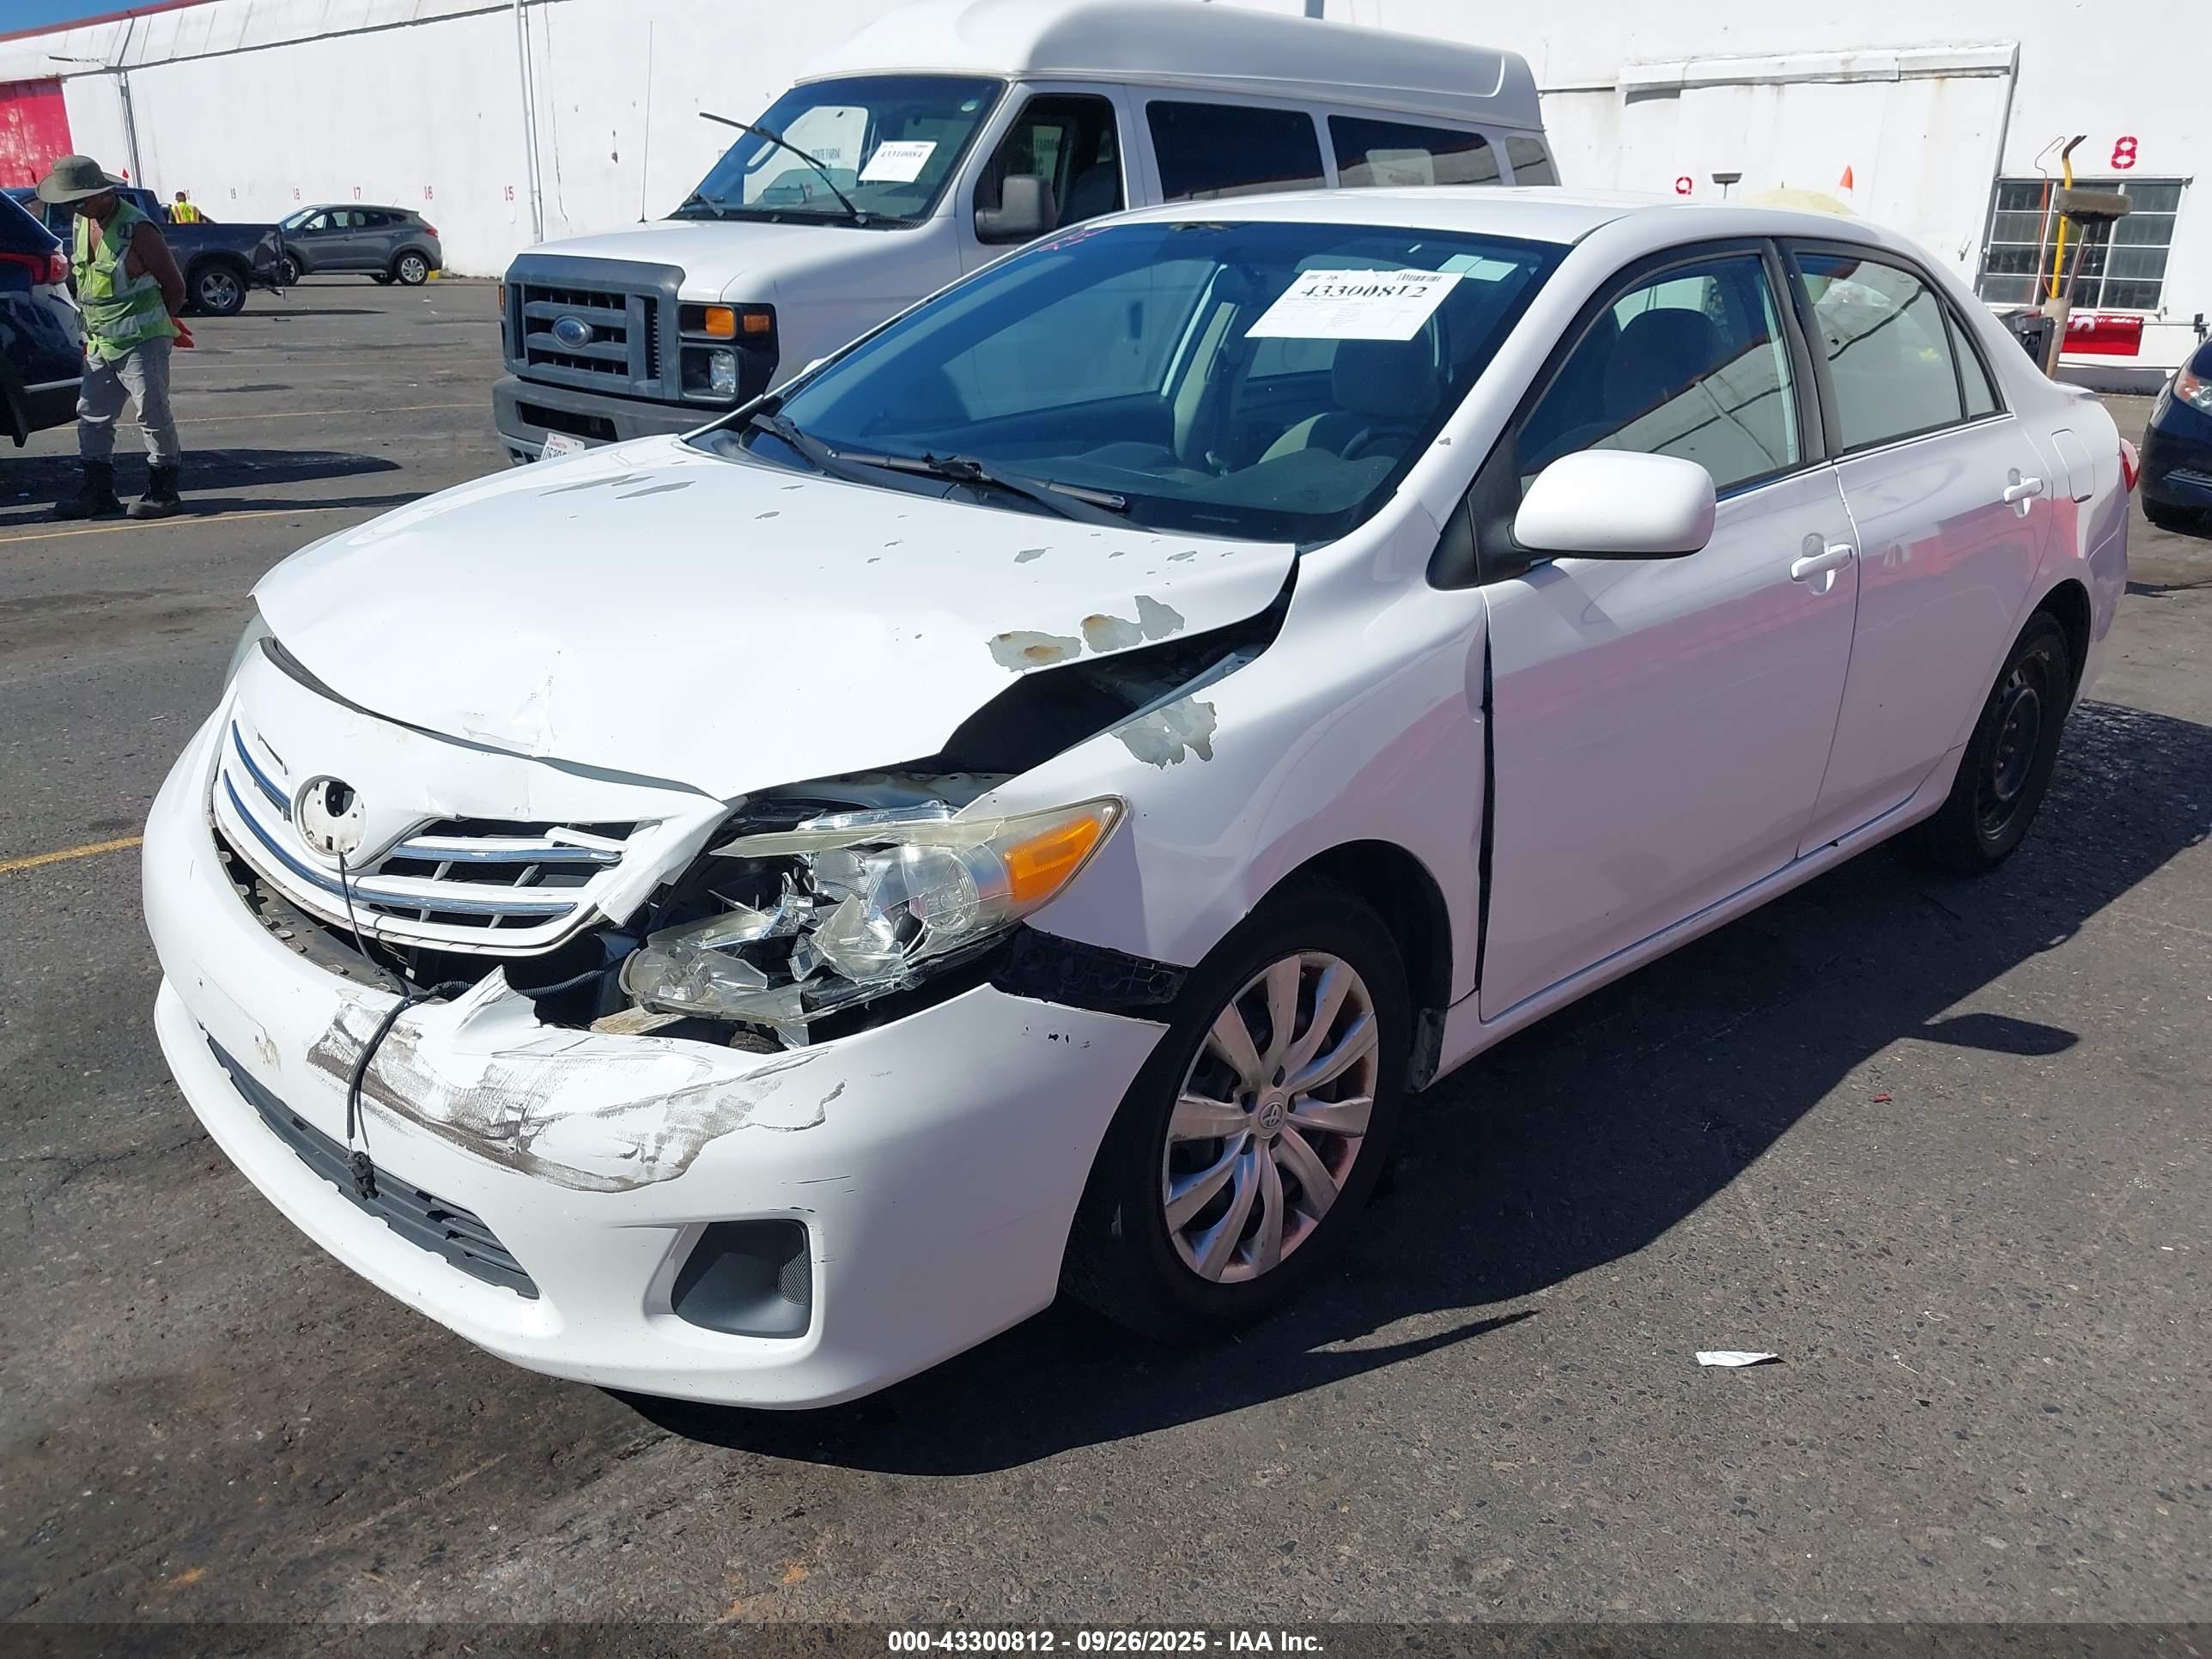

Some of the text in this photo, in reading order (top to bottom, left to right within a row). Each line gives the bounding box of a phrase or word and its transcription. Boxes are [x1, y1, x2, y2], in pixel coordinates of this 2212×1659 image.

[2111, 136, 2137, 170] 8
[353, 186, 362, 200] 17
[424, 185, 434, 200] 16
[504, 185, 514, 201] 15
[1300, 284, 1429, 299] 43300812
